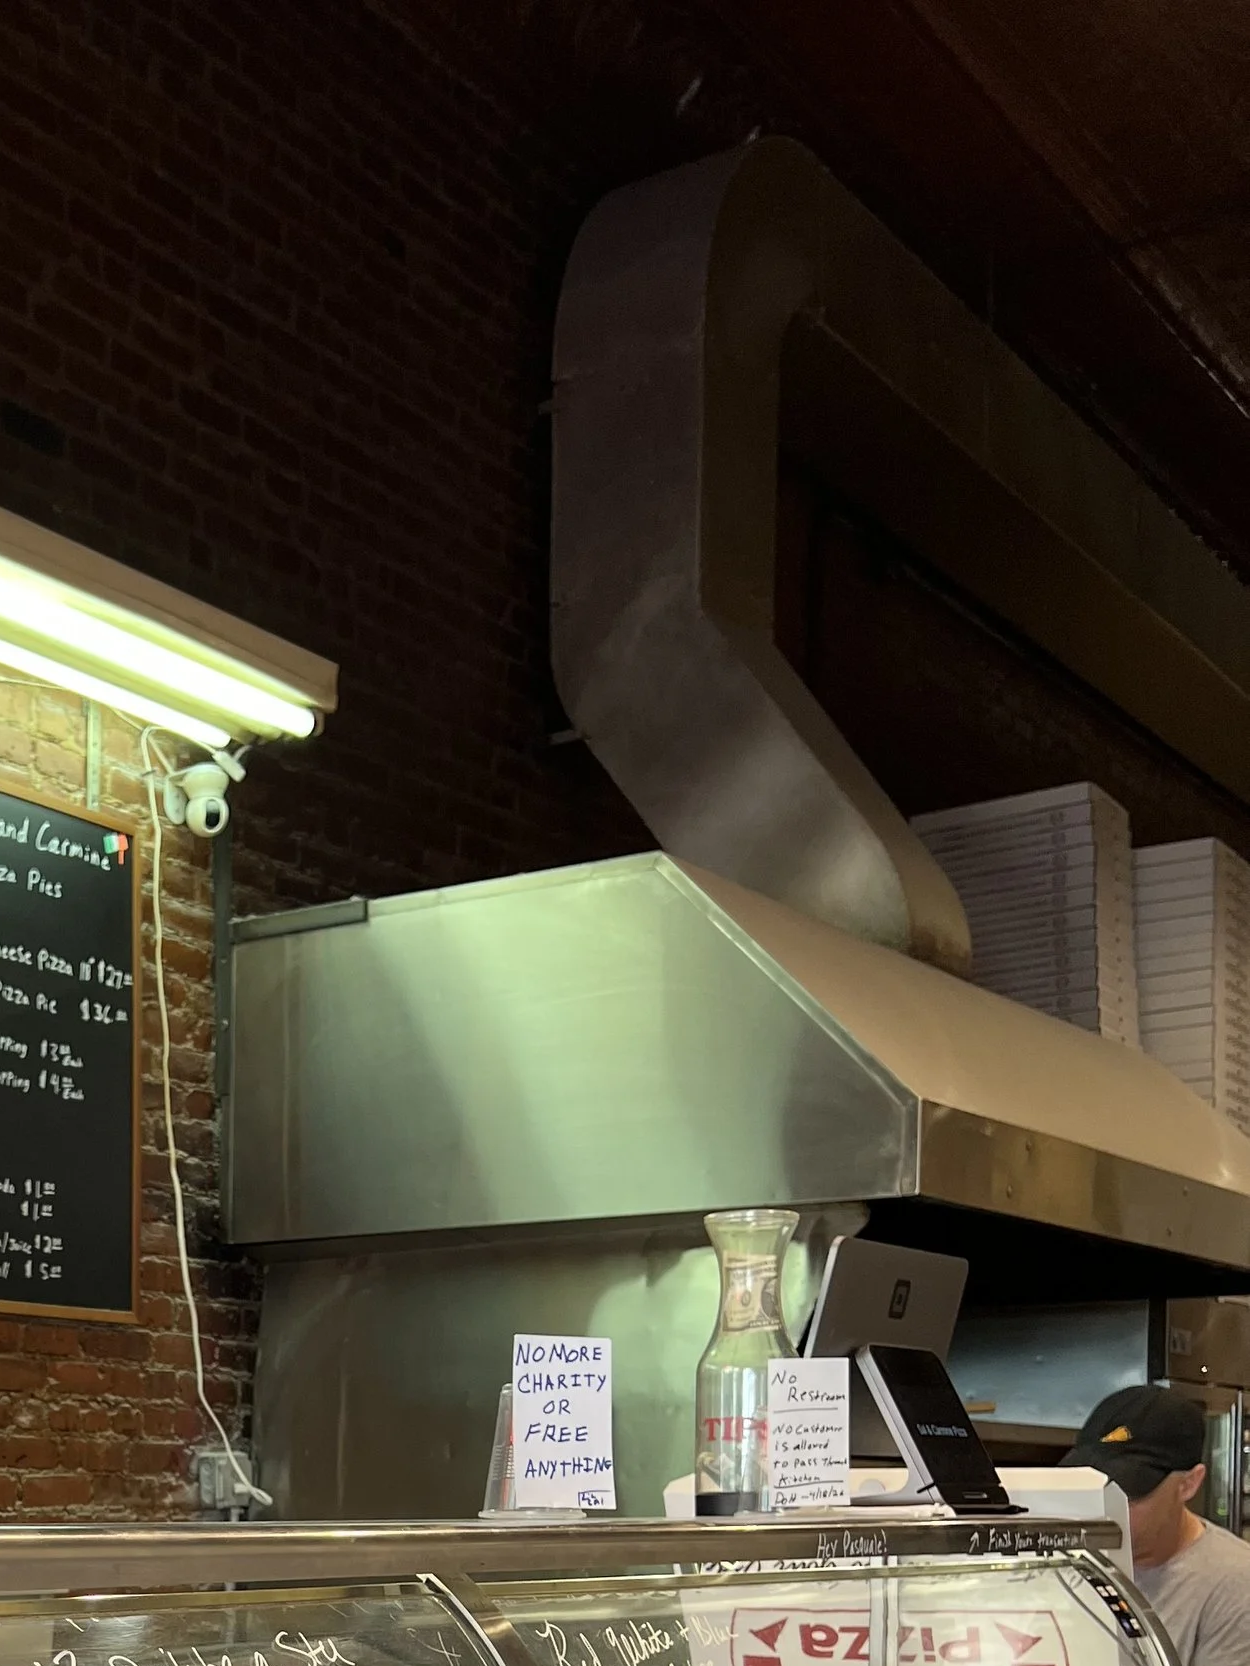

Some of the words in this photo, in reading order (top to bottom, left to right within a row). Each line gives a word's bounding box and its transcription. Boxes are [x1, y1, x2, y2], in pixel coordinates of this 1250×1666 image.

[35, 821, 111, 871] Carmine
[27, 867, 63, 899] Pies
[37, 948, 73, 976] Pizza
[36, 993, 57, 1014] Pie
[516, 1343, 545, 1366] NO
[518, 1373, 606, 1393] CHARITY
[771, 1370, 797, 1386] No
[543, 1399, 571, 1415] OR
[525, 1423, 588, 1443] FREE
[793, 1439, 829, 1451] allowed
[817, 1533, 838, 1559] Hey
